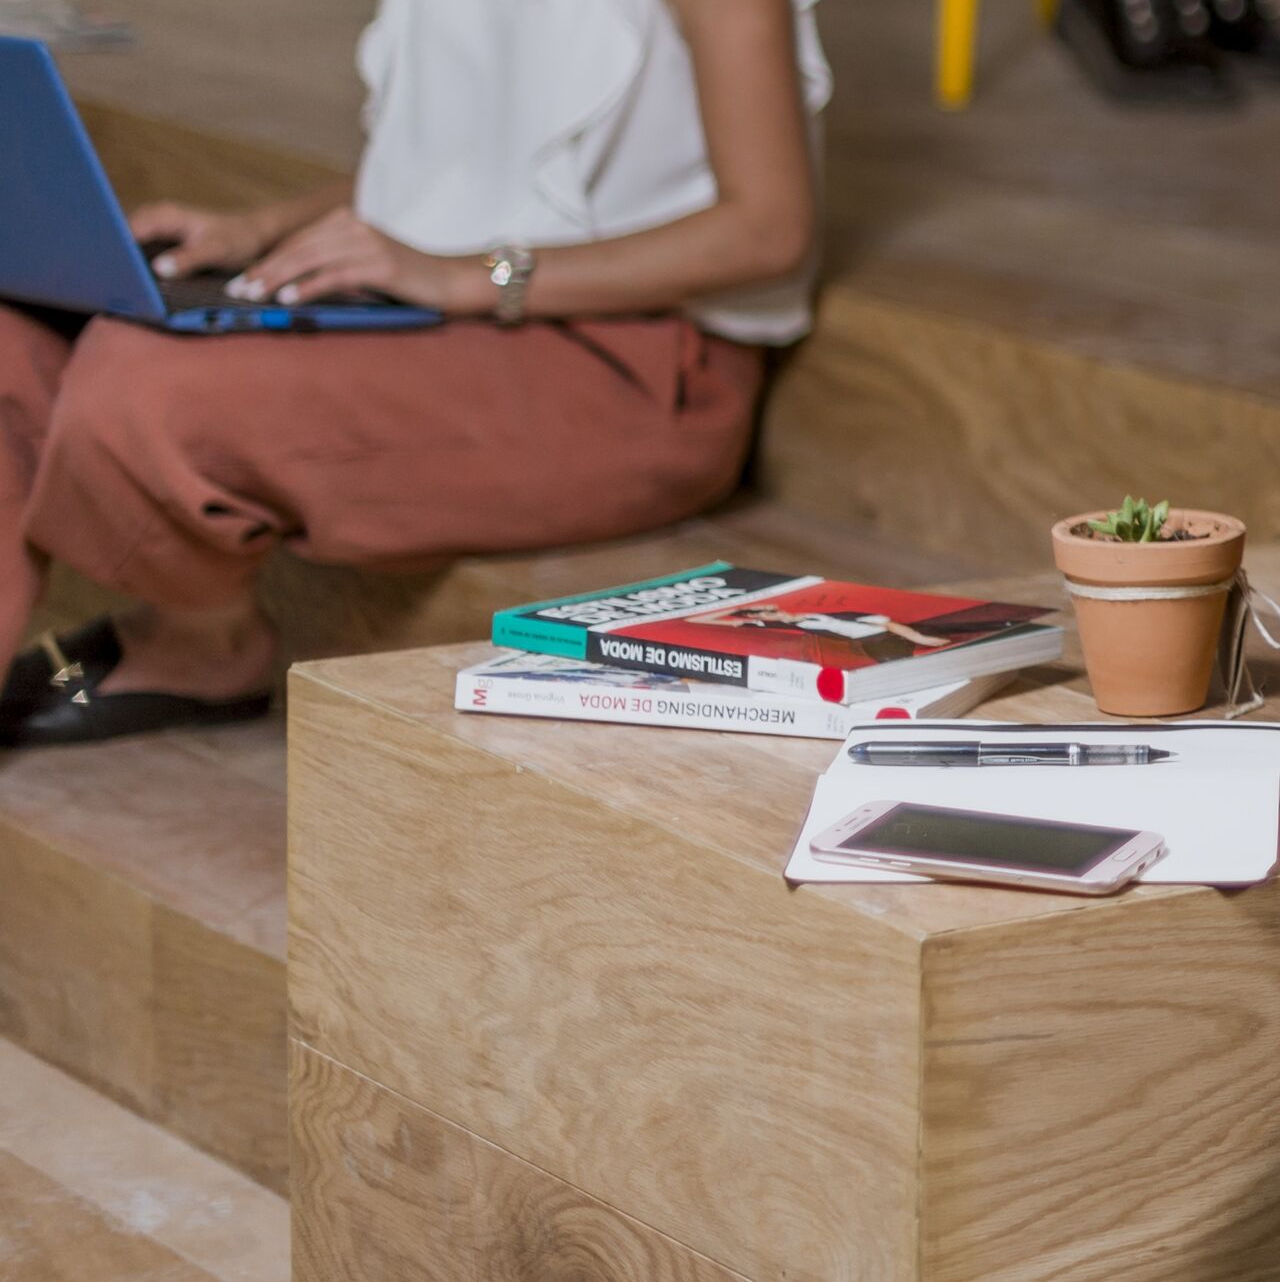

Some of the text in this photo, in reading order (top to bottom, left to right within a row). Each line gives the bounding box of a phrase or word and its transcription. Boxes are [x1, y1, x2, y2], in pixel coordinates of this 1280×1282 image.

[537, 576, 727, 619] ESTILISMO
[600, 638, 643, 662] MODA
[645, 645, 666, 666] DE
[668, 651, 742, 679] ESTILISMO
[579, 694, 796, 725] MERCHANDISING DE MODA
